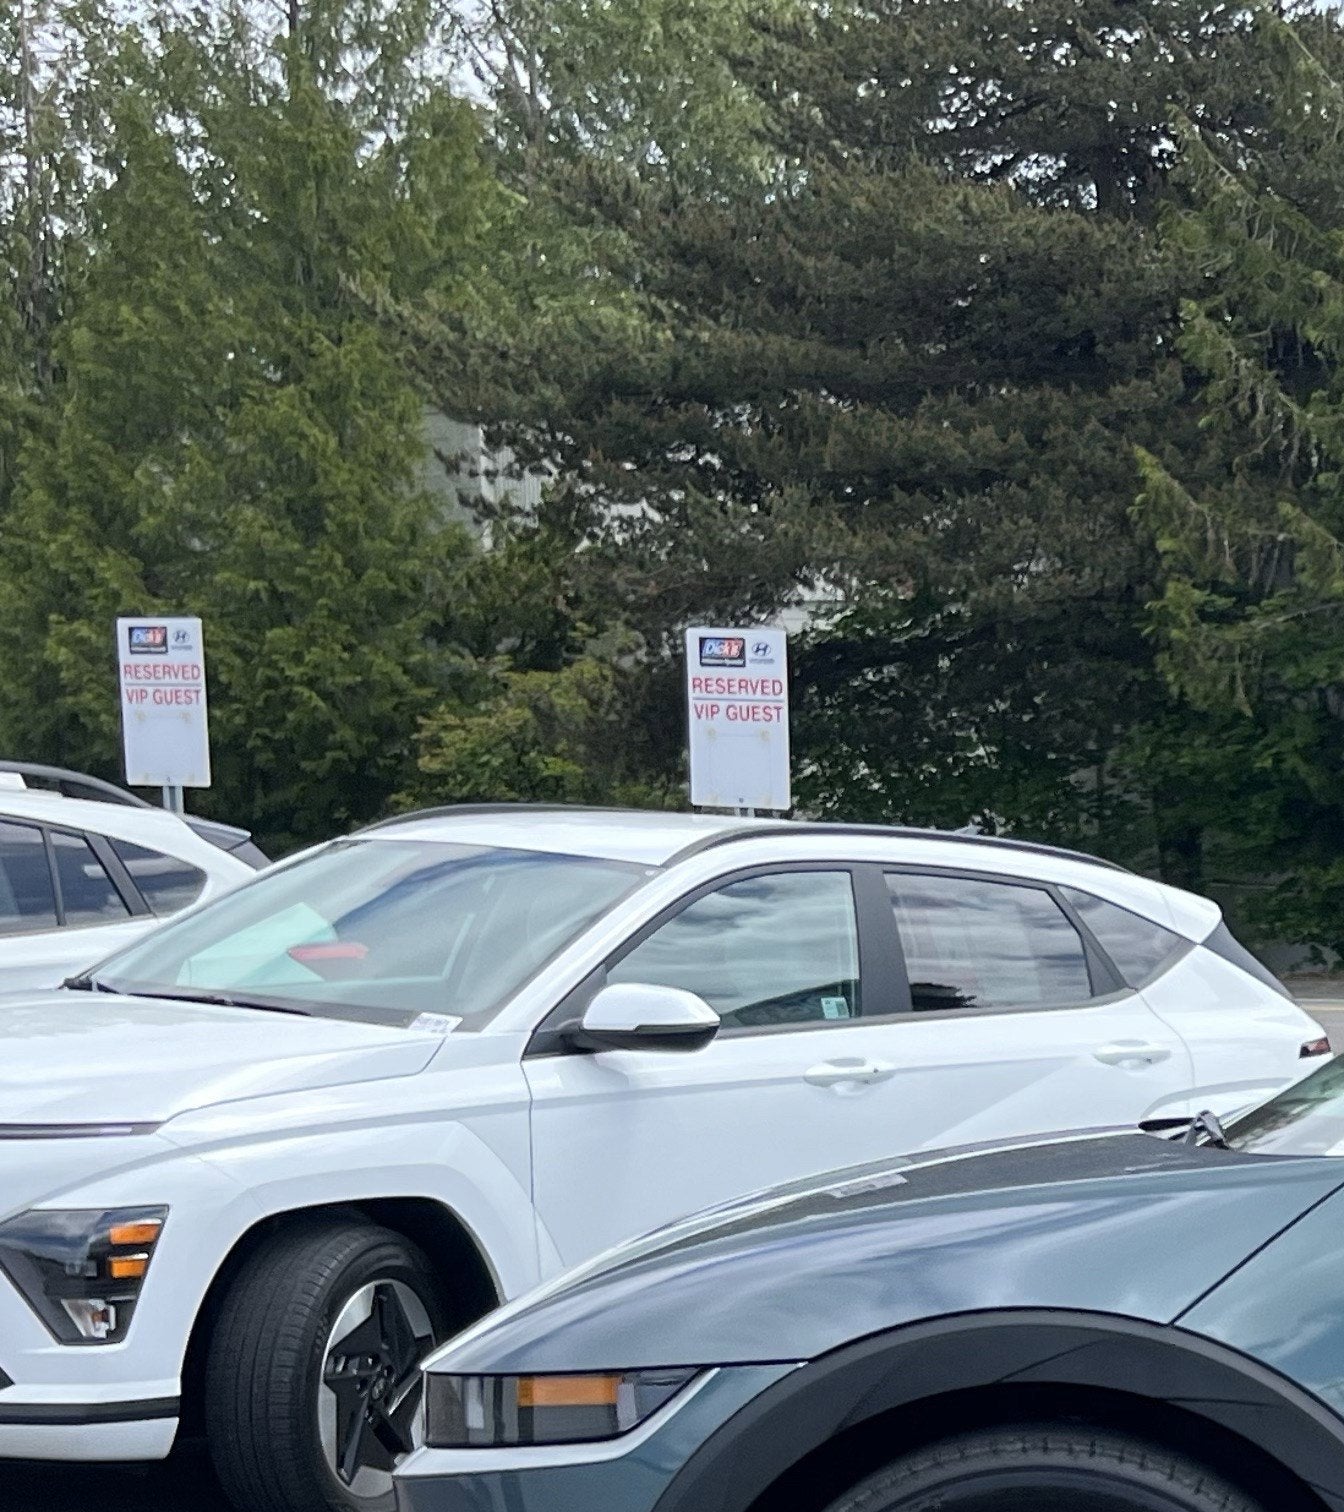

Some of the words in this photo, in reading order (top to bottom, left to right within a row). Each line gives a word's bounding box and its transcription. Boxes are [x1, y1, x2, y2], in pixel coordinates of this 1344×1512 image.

[123, 663, 201, 681] RESERVED
[692, 677, 784, 696] RESERVED
[126, 688, 148, 705] VIP
[153, 688, 202, 706] GUEST
[693, 703, 721, 721] VIP
[726, 704, 784, 723] GUEST
